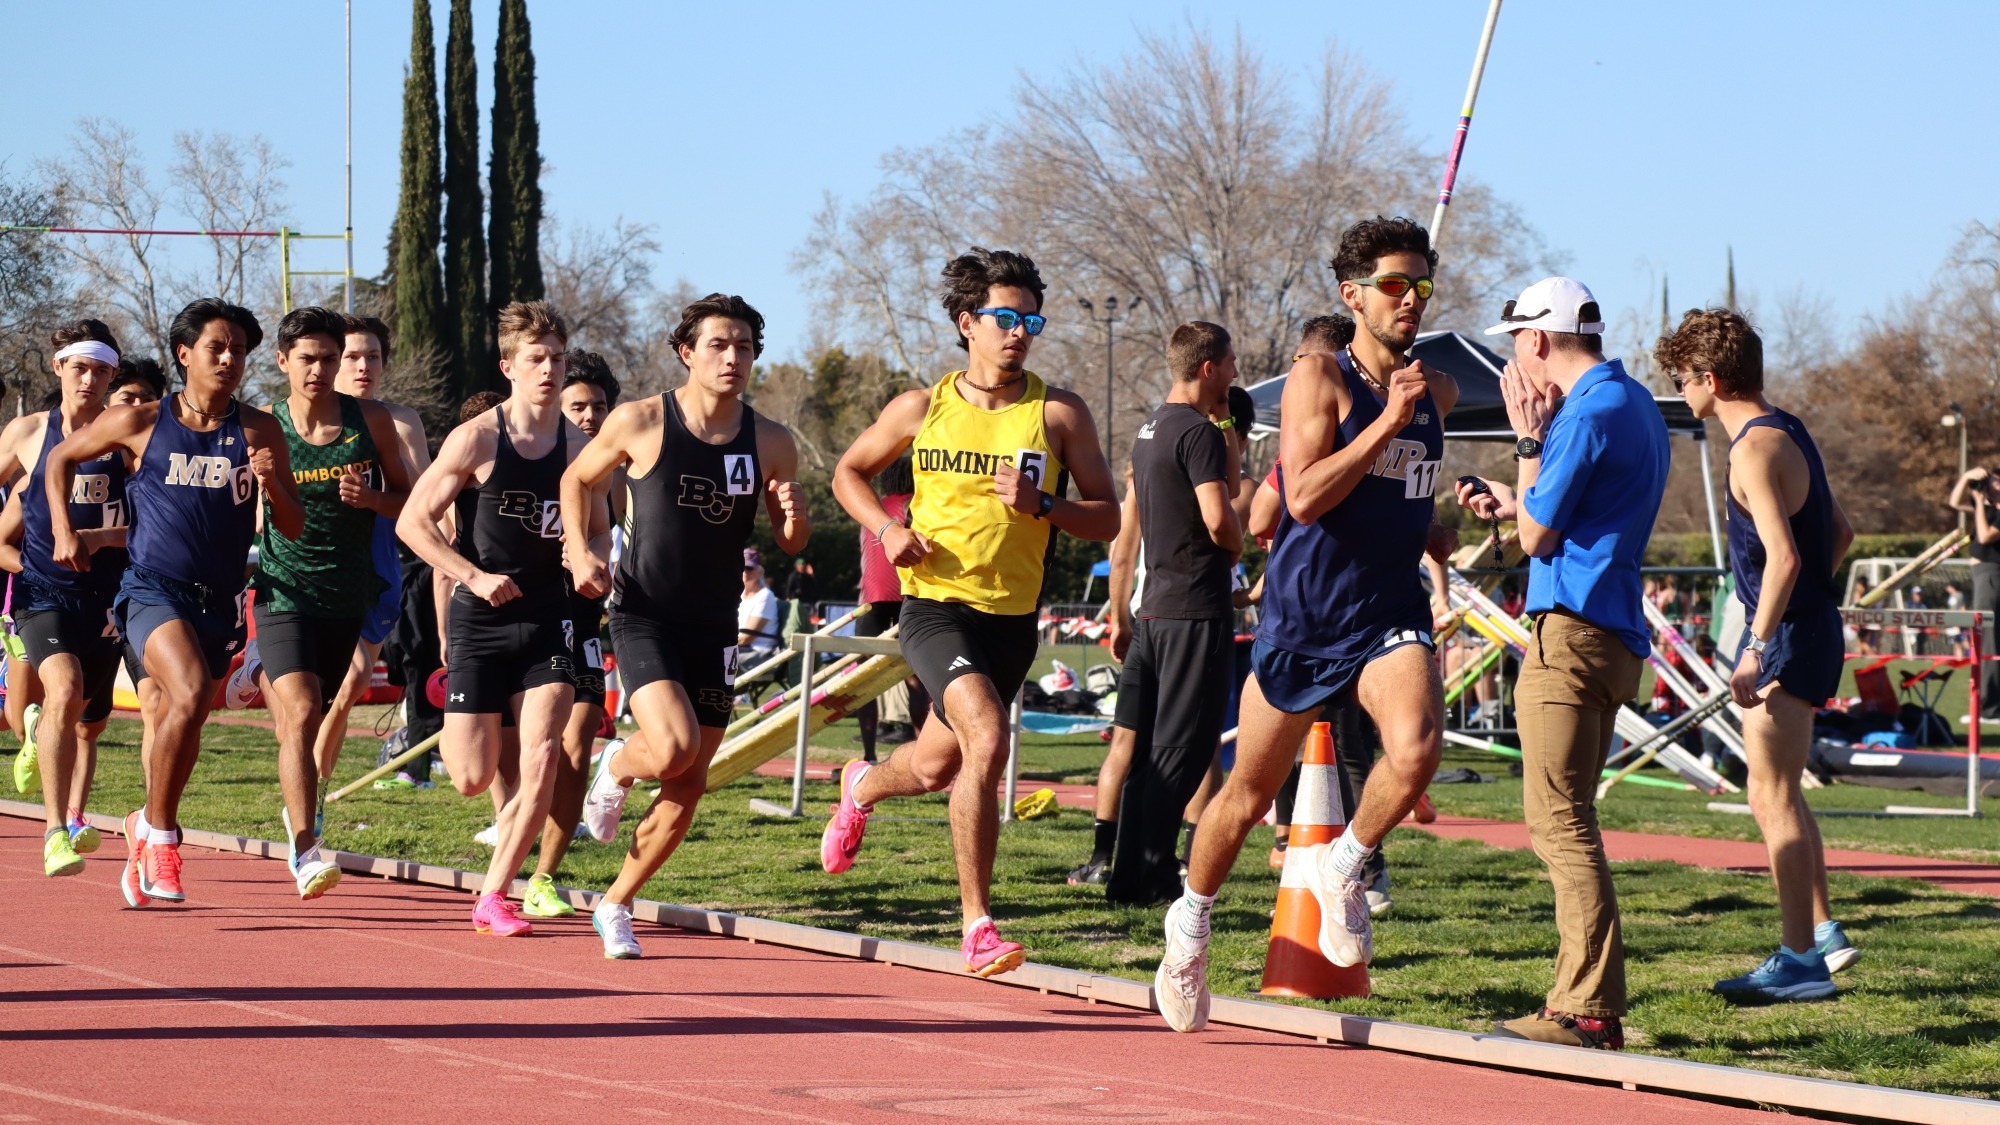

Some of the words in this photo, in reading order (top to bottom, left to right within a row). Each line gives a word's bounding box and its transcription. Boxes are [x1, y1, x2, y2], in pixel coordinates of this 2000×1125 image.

[165, 452, 232, 489] MB
[236, 467, 250, 501] 6
[293, 459, 373, 485] UMBOLDT
[730, 456, 751, 492] 4
[1020, 452, 1042, 489] 5
[1413, 463, 1442, 497] 11
[107, 503, 120, 528] 7
[678, 474, 736, 525] BC
[544, 503, 562, 536] 2
[1840, 611, 1885, 624] HICO
[1892, 611, 1945, 625] STATE
